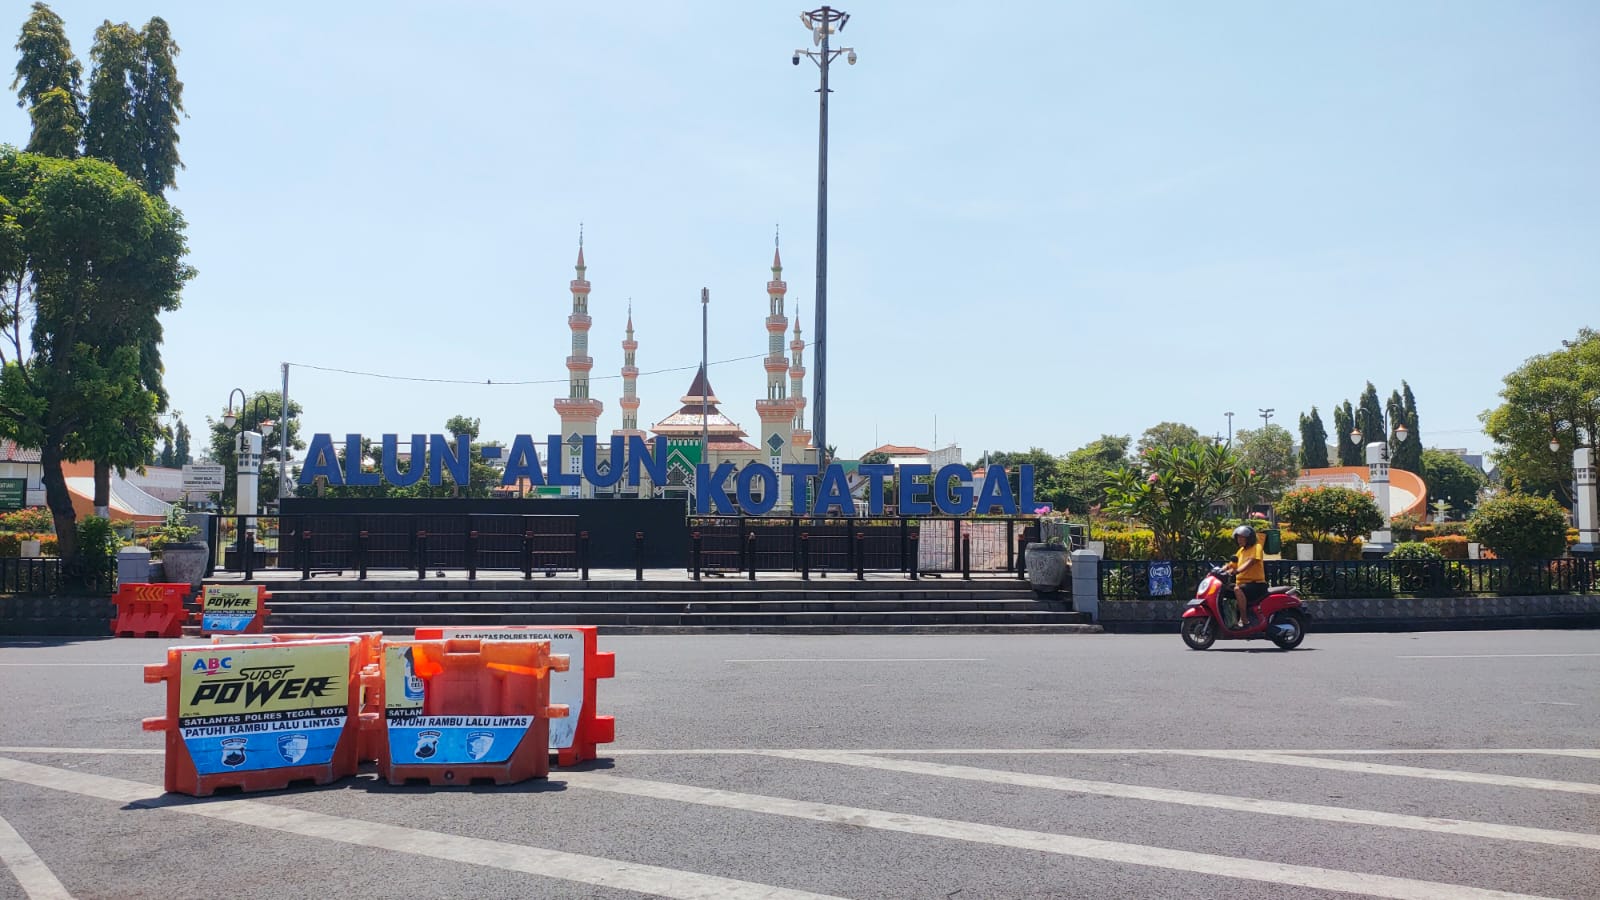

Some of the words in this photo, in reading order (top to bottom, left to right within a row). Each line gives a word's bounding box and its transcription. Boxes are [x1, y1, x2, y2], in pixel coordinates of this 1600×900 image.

[207, 598, 254, 608] POWER
[192, 656, 232, 671] ABC
[230, 666, 295, 682] Super
[189, 676, 341, 709] POWER
[184, 715, 241, 727] SATLANTAS
[245, 712, 282, 721] POLRES
[286, 709, 317, 719] TEGAL
[320, 707, 345, 716] KOTA
[390, 718, 426, 727] PATUHI
[428, 718, 463, 727] RAMBU
[465, 718, 489, 727] LALU
[493, 718, 527, 727] LINTAS
[185, 726, 226, 738] PATUHI
[230, 722, 269, 735] RAMBU
[272, 720, 300, 731] LALU
[302, 717, 341, 729] LINTAS
